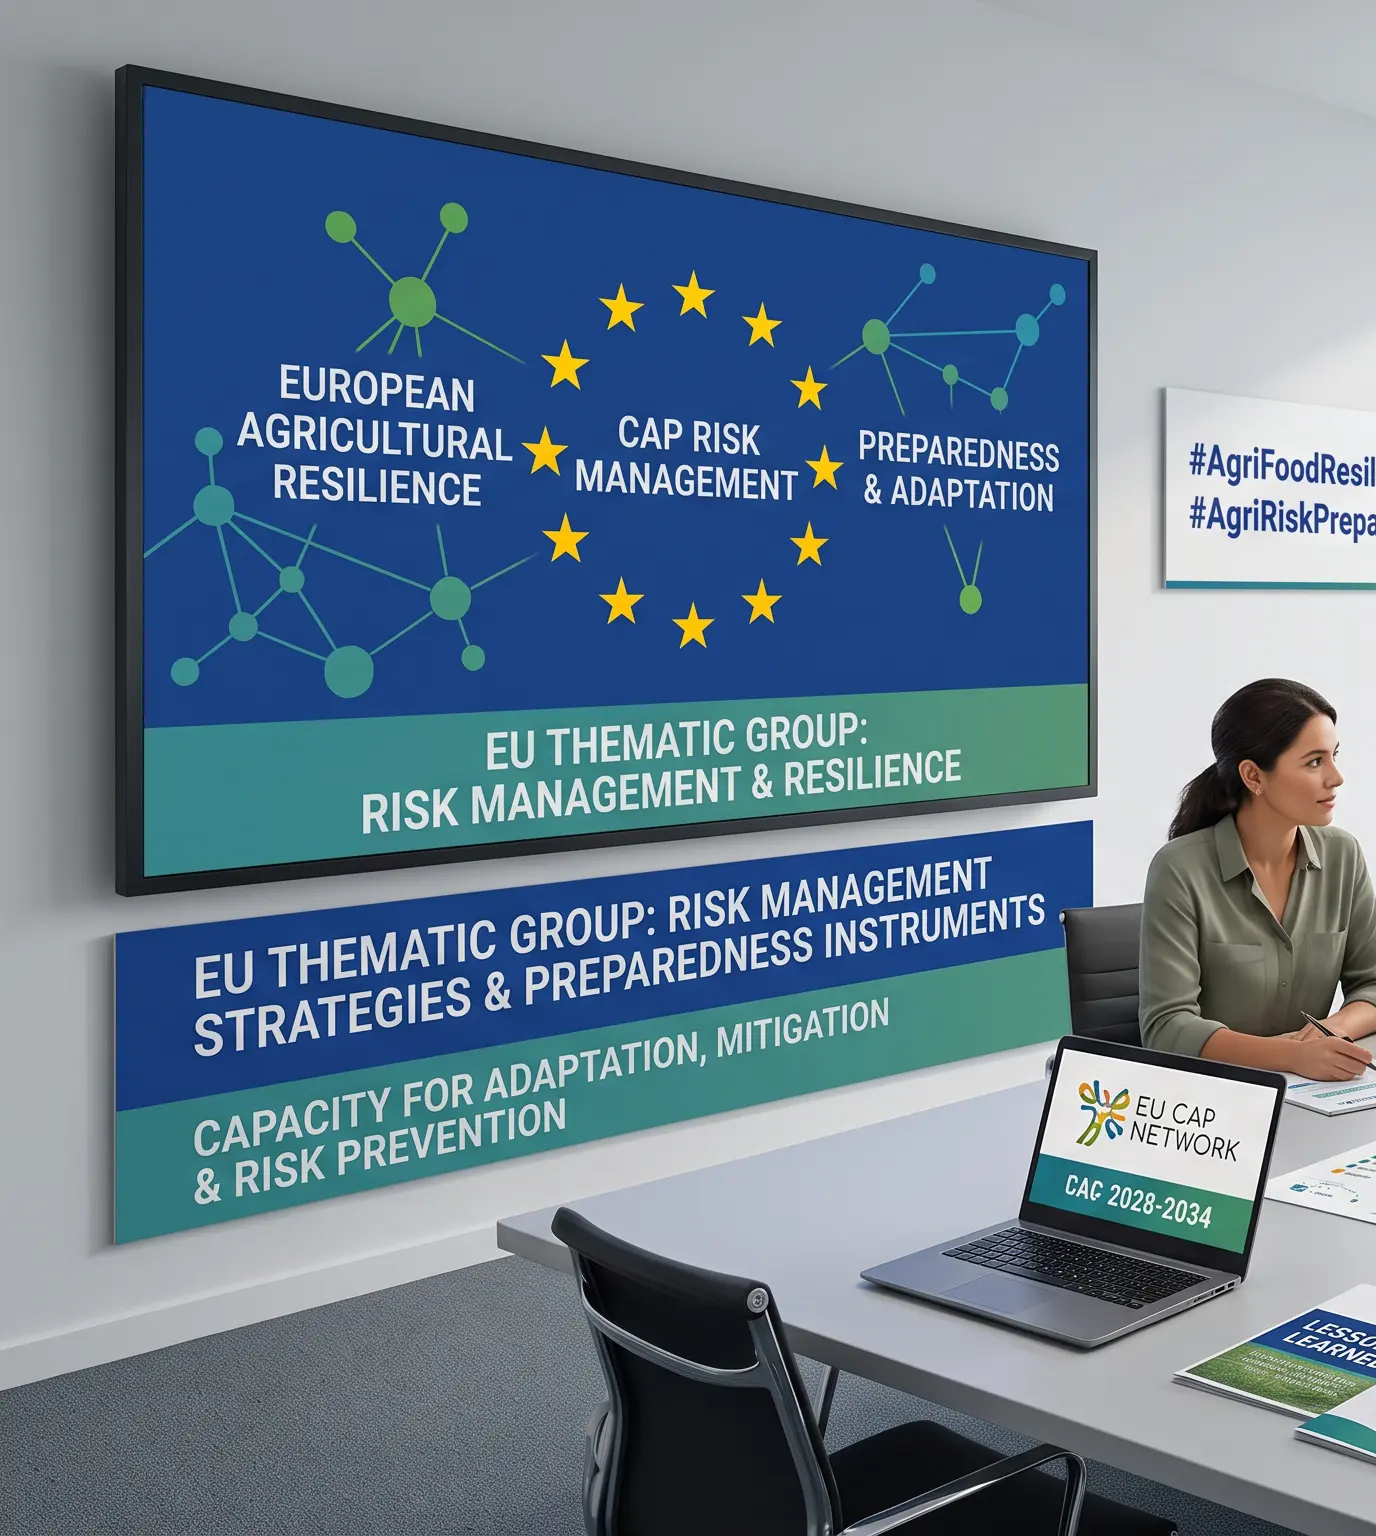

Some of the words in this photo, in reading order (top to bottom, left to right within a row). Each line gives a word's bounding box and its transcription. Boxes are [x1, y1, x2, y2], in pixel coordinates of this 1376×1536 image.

[281, 365, 473, 412] EUROPEAN
[237, 412, 512, 461] AGRICULTURAL
[619, 416, 682, 449] CAP
[694, 421, 760, 455] RISK
[860, 430, 1059, 472] PREPAREDNESS
[275, 464, 480, 506] RESILIENCE
[577, 459, 798, 500] MANAGEMENT
[865, 474, 881, 503] &
[891, 476, 1052, 511] ADAPTATION
[488, 731, 534, 770] EU
[547, 719, 734, 765] THEMATIC
[747, 713, 866, 752] GROUP:
[363, 788, 458, 834] RISK
[473, 766, 741, 824] MANAGEMENT
[752, 764, 773, 799] &
[786, 749, 961, 796] RESILIENCE
[196, 951, 252, 998] EU
[269, 920, 495, 987] THEMATIC
[511, 902, 654, 953] GROUP:
[670, 887, 750, 932] RISK
[762, 856, 992, 919] MANAGEMENT
[195, 978, 470, 1056] STRATEGIES
[485, 972, 511, 1011] &
[526, 927, 812, 1005] PREPAREDNESS
[826, 894, 1044, 957] INSTRUMENTS
[195, 1087, 391, 1156] CAPACITY
[405, 1074, 473, 1117] FOR
[484, 1032, 705, 1101] ADAPTATION,
[718, 998, 888, 1057] MITIGATION
[1136, 1096, 1165, 1119] EU
[1173, 1103, 1215, 1128] CAP
[195, 1168, 221, 1204] &
[236, 1146, 325, 1196] RISK
[338, 1097, 567, 1176] PREVENTION
[1131, 1121, 1239, 1161] NETWORK
[1108, 1185, 1211, 1228] 2028-2034
